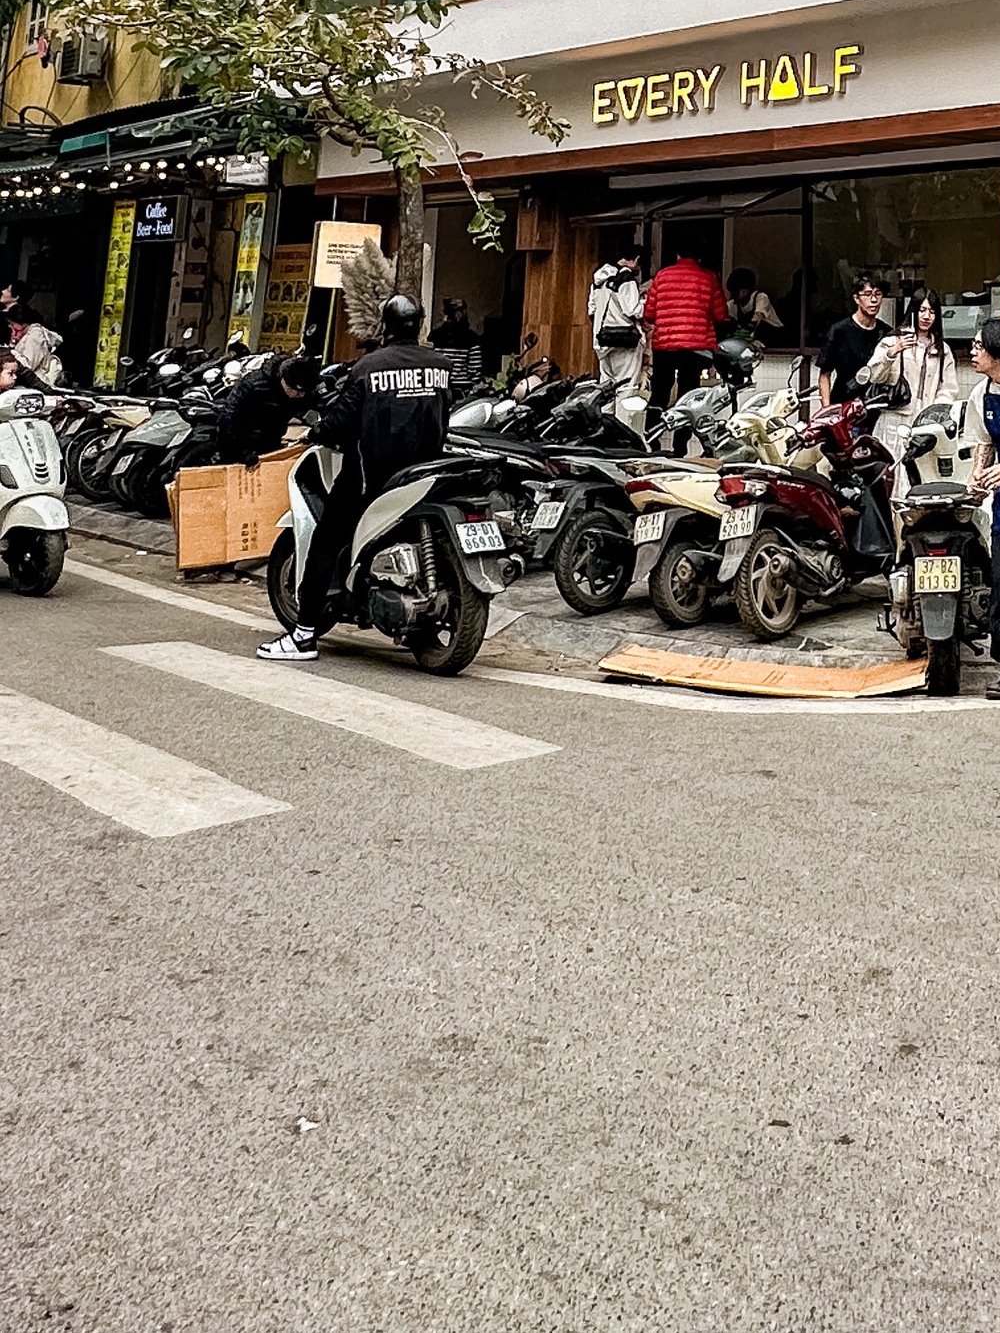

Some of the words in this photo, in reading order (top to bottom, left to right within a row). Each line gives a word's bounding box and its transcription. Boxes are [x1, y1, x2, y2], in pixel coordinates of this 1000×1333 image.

[593, 65, 721, 123] EVERY
[739, 45, 859, 104] HALF
[145, 202, 168, 220] Coffee
[370, 369, 422, 393] FUTURE
